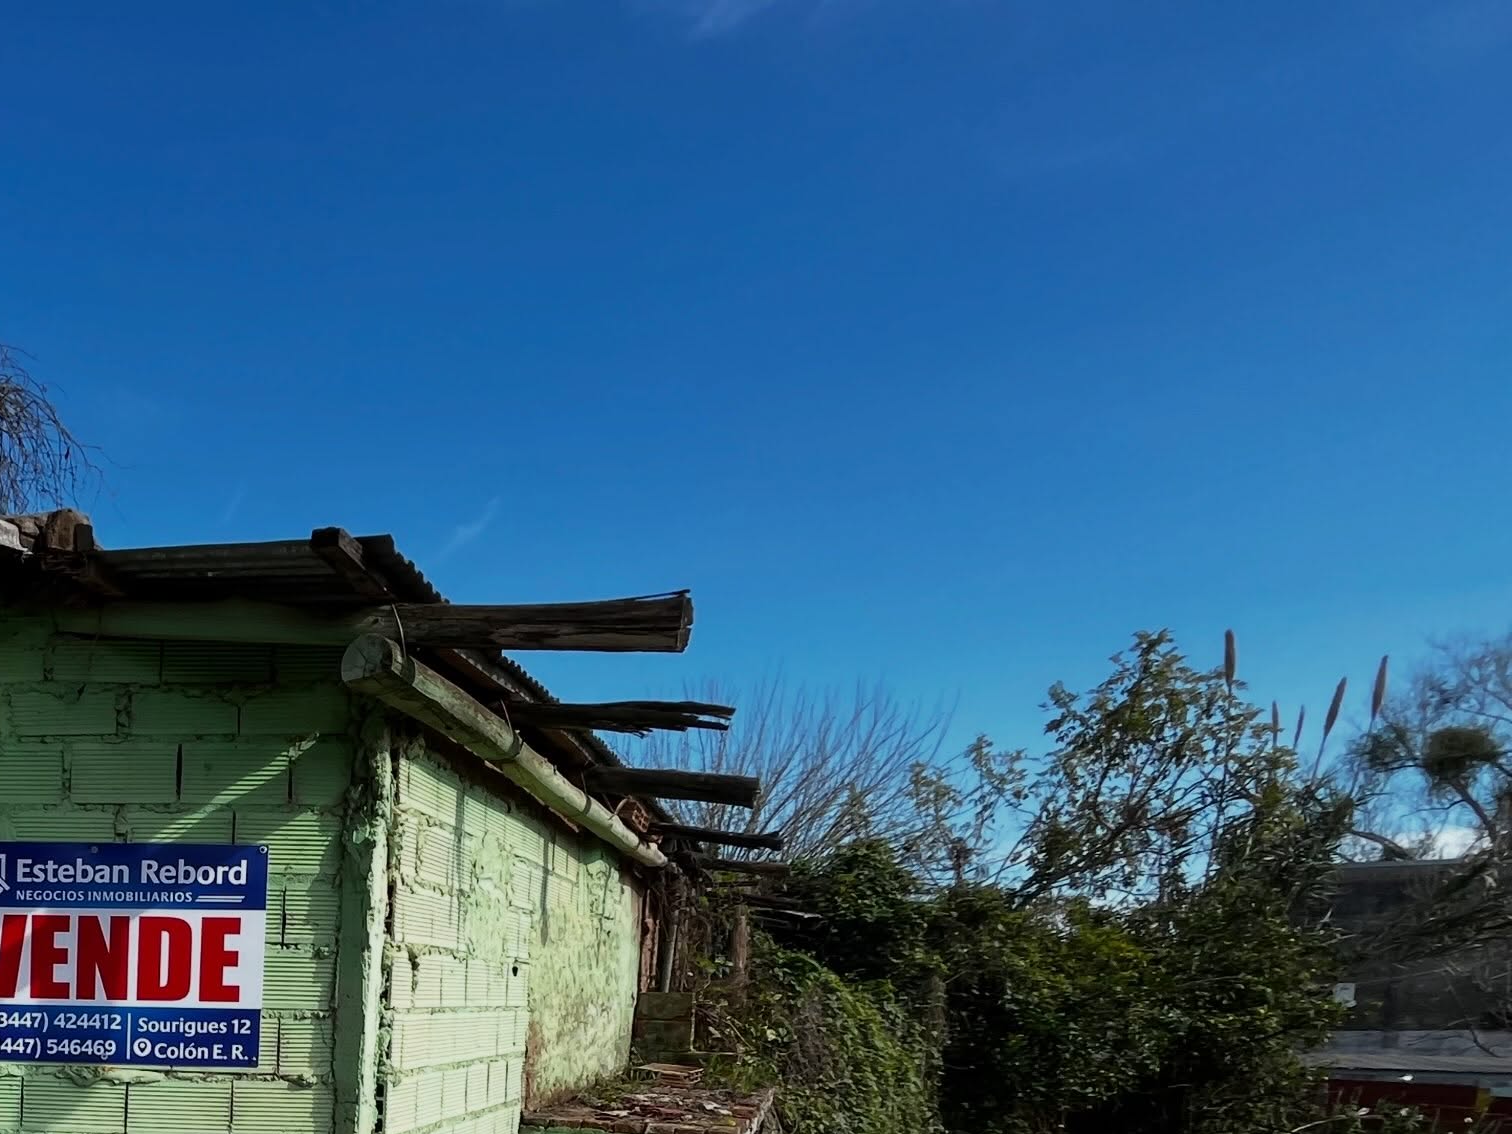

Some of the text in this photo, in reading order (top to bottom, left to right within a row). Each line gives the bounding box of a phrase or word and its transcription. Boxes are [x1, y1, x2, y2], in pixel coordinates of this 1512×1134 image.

[16, 858, 248, 885] Esteban Rebord
[16, 890, 193, 902] NEGOCIOS INMOBILIARIOS
[53, 1012, 122, 1030] 424412
[137, 1017, 251, 1037] Sourigues 12
[46, 1038, 117, 1056] 546469
[154, 1042, 209, 1060] Colón
[212, 1044, 228, 1060] E.
